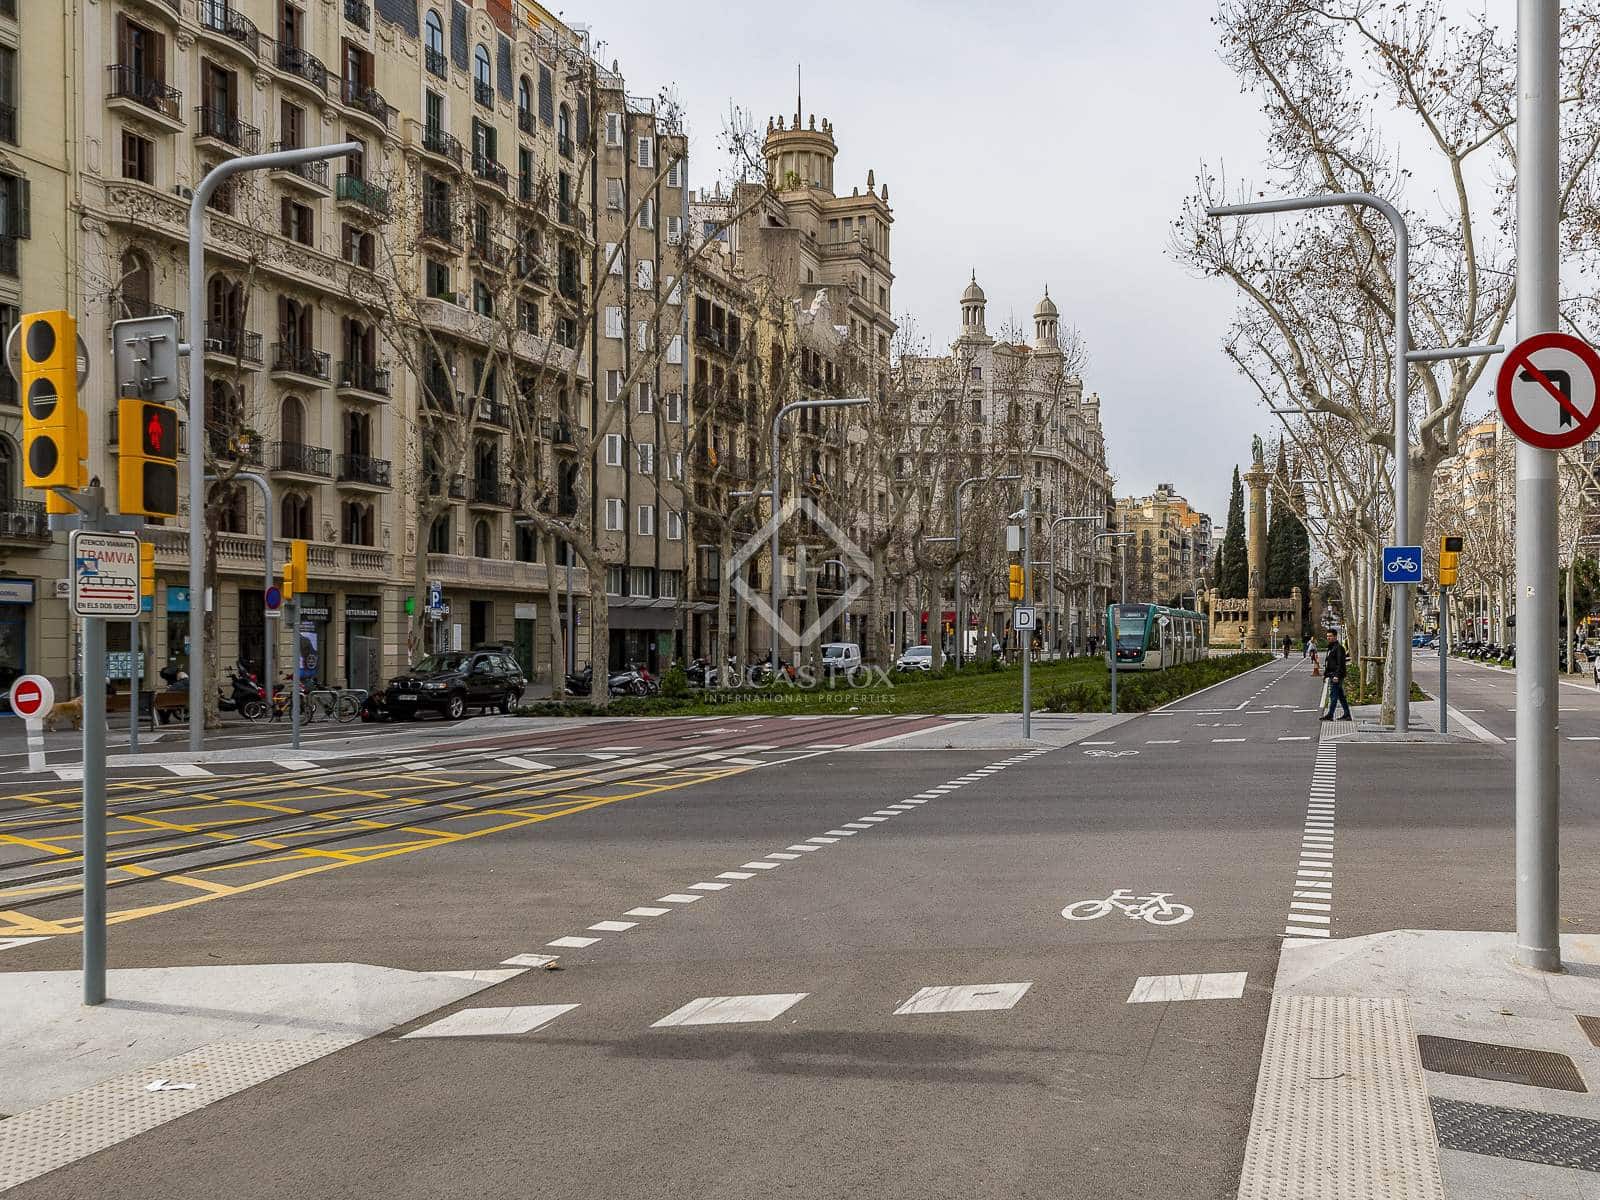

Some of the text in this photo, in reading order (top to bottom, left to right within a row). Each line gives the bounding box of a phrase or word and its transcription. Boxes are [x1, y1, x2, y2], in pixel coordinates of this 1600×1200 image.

[80, 538, 105, 546] ATENCIÓ
[79, 549, 135, 564] TRAMVIA
[432, 591, 440, 607] P
[1019, 611, 1030, 625] D
